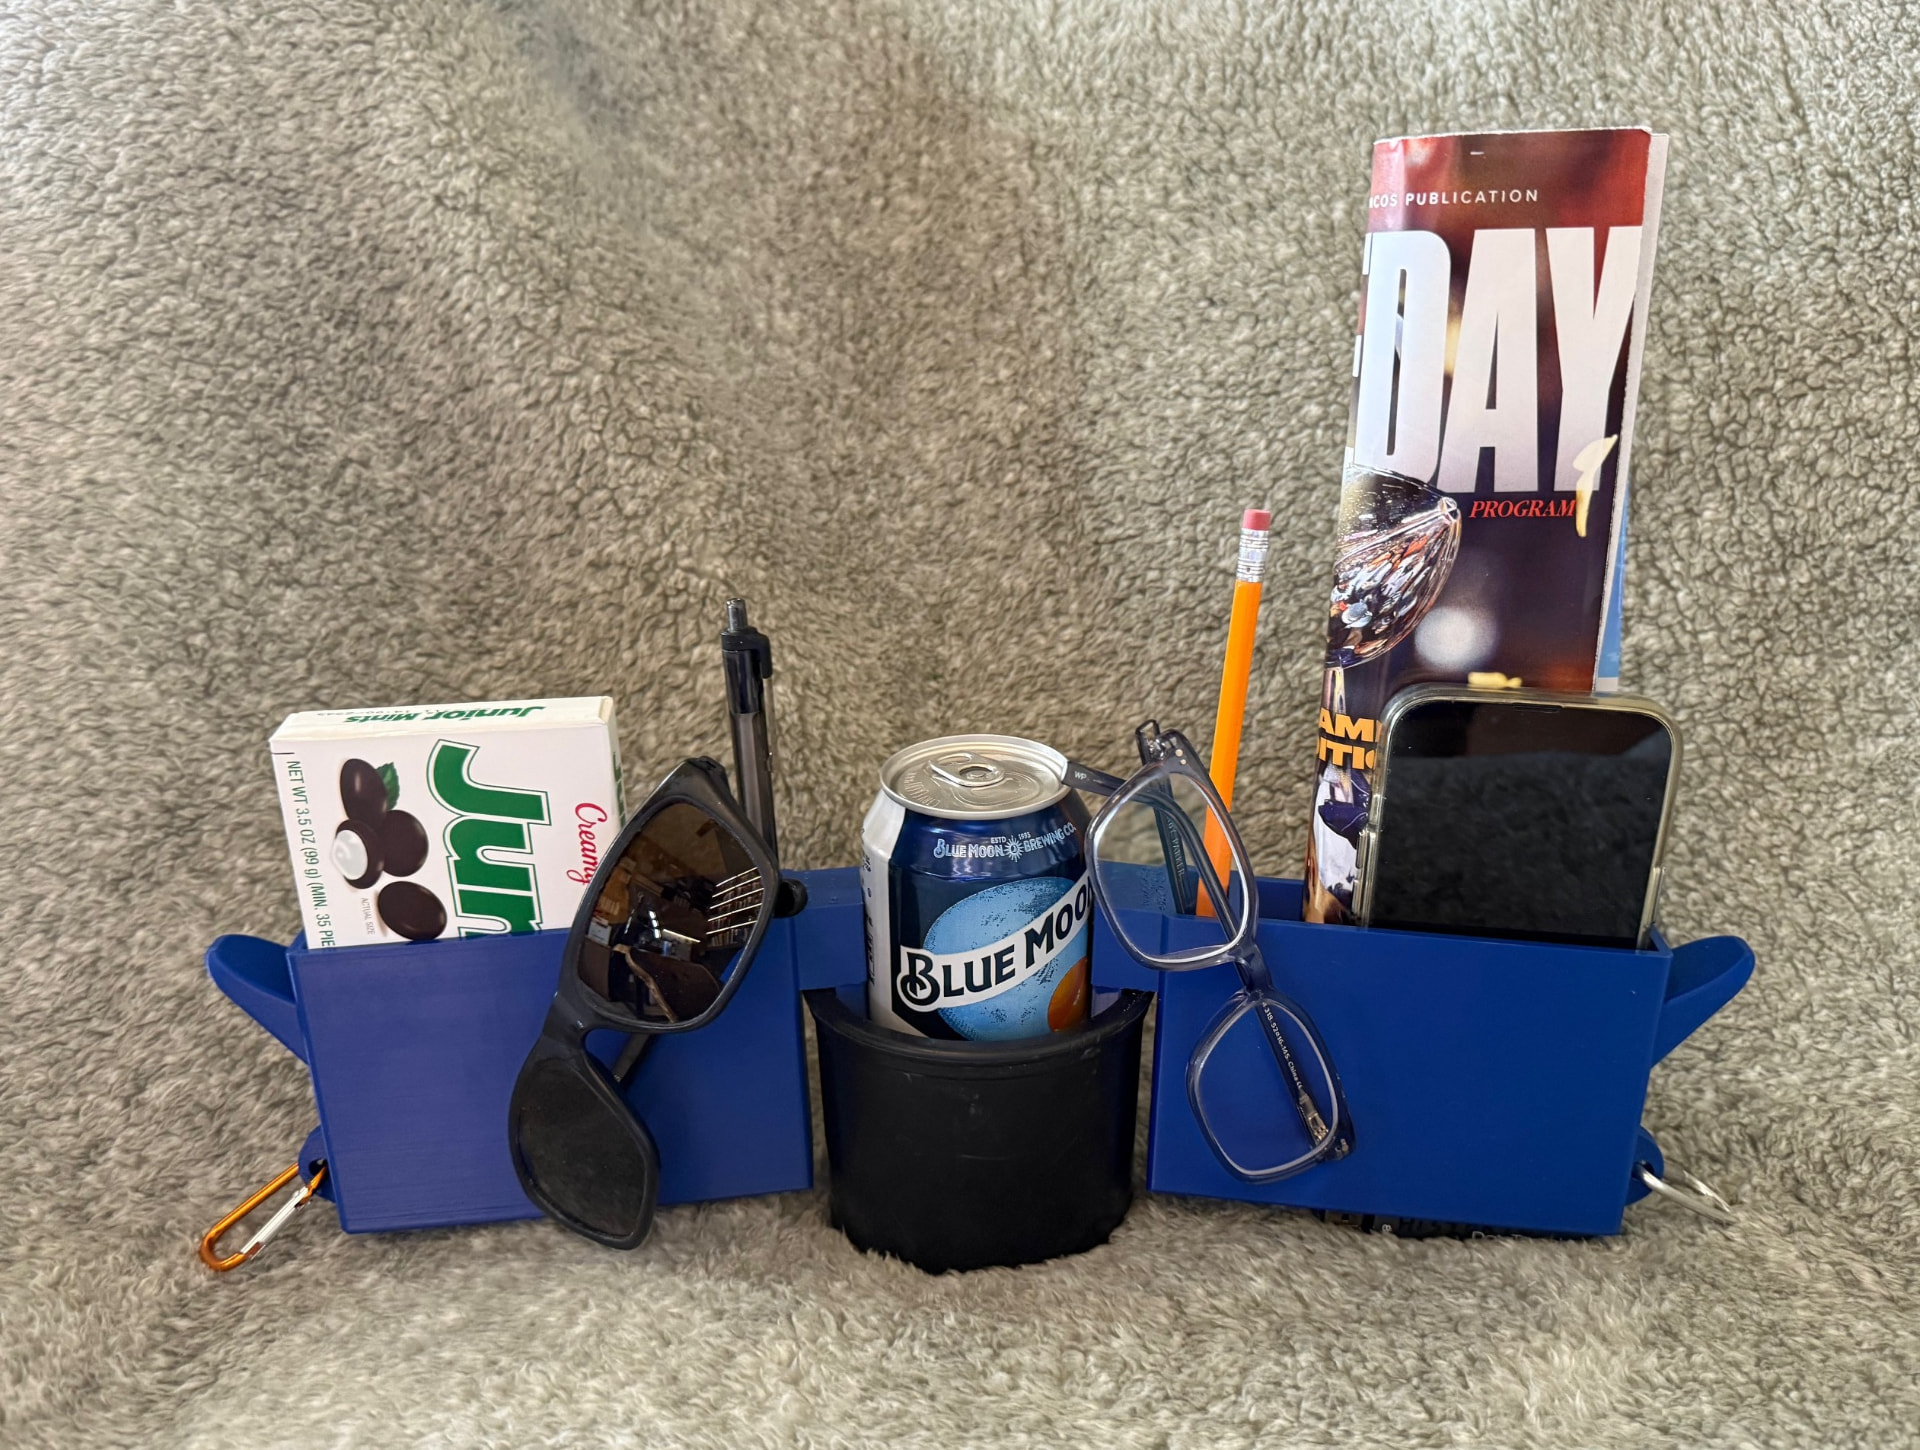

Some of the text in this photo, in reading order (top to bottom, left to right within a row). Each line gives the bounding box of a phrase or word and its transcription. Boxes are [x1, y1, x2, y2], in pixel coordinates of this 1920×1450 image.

[1405, 189, 1539, 207] PUBLICATION
[1345, 225, 1643, 493] DAY
[1468, 499, 1575, 519] PROGRAM
[344, 712, 421, 723] Mints
[422, 706, 546, 721] Junior
[1316, 736, 1376, 770] ITI
[287, 761, 304, 783] NET
[291, 786, 308, 804] WT
[295, 808, 312, 826] 3.5
[300, 829, 316, 844] OZ
[566, 802, 608, 885] Creamy
[933, 838, 967, 858] BLUE
[968, 843, 1005, 858] MOON
[1023, 828, 1066, 853] BREWING
[300, 847, 319, 865] (99
[304, 868, 322, 879] g)
[307, 882, 328, 910] (MIN.
[316, 913, 331, 927] 35
[361, 897, 376, 935] ACTUAL SIZE
[900, 944, 1017, 1006] BLUE
